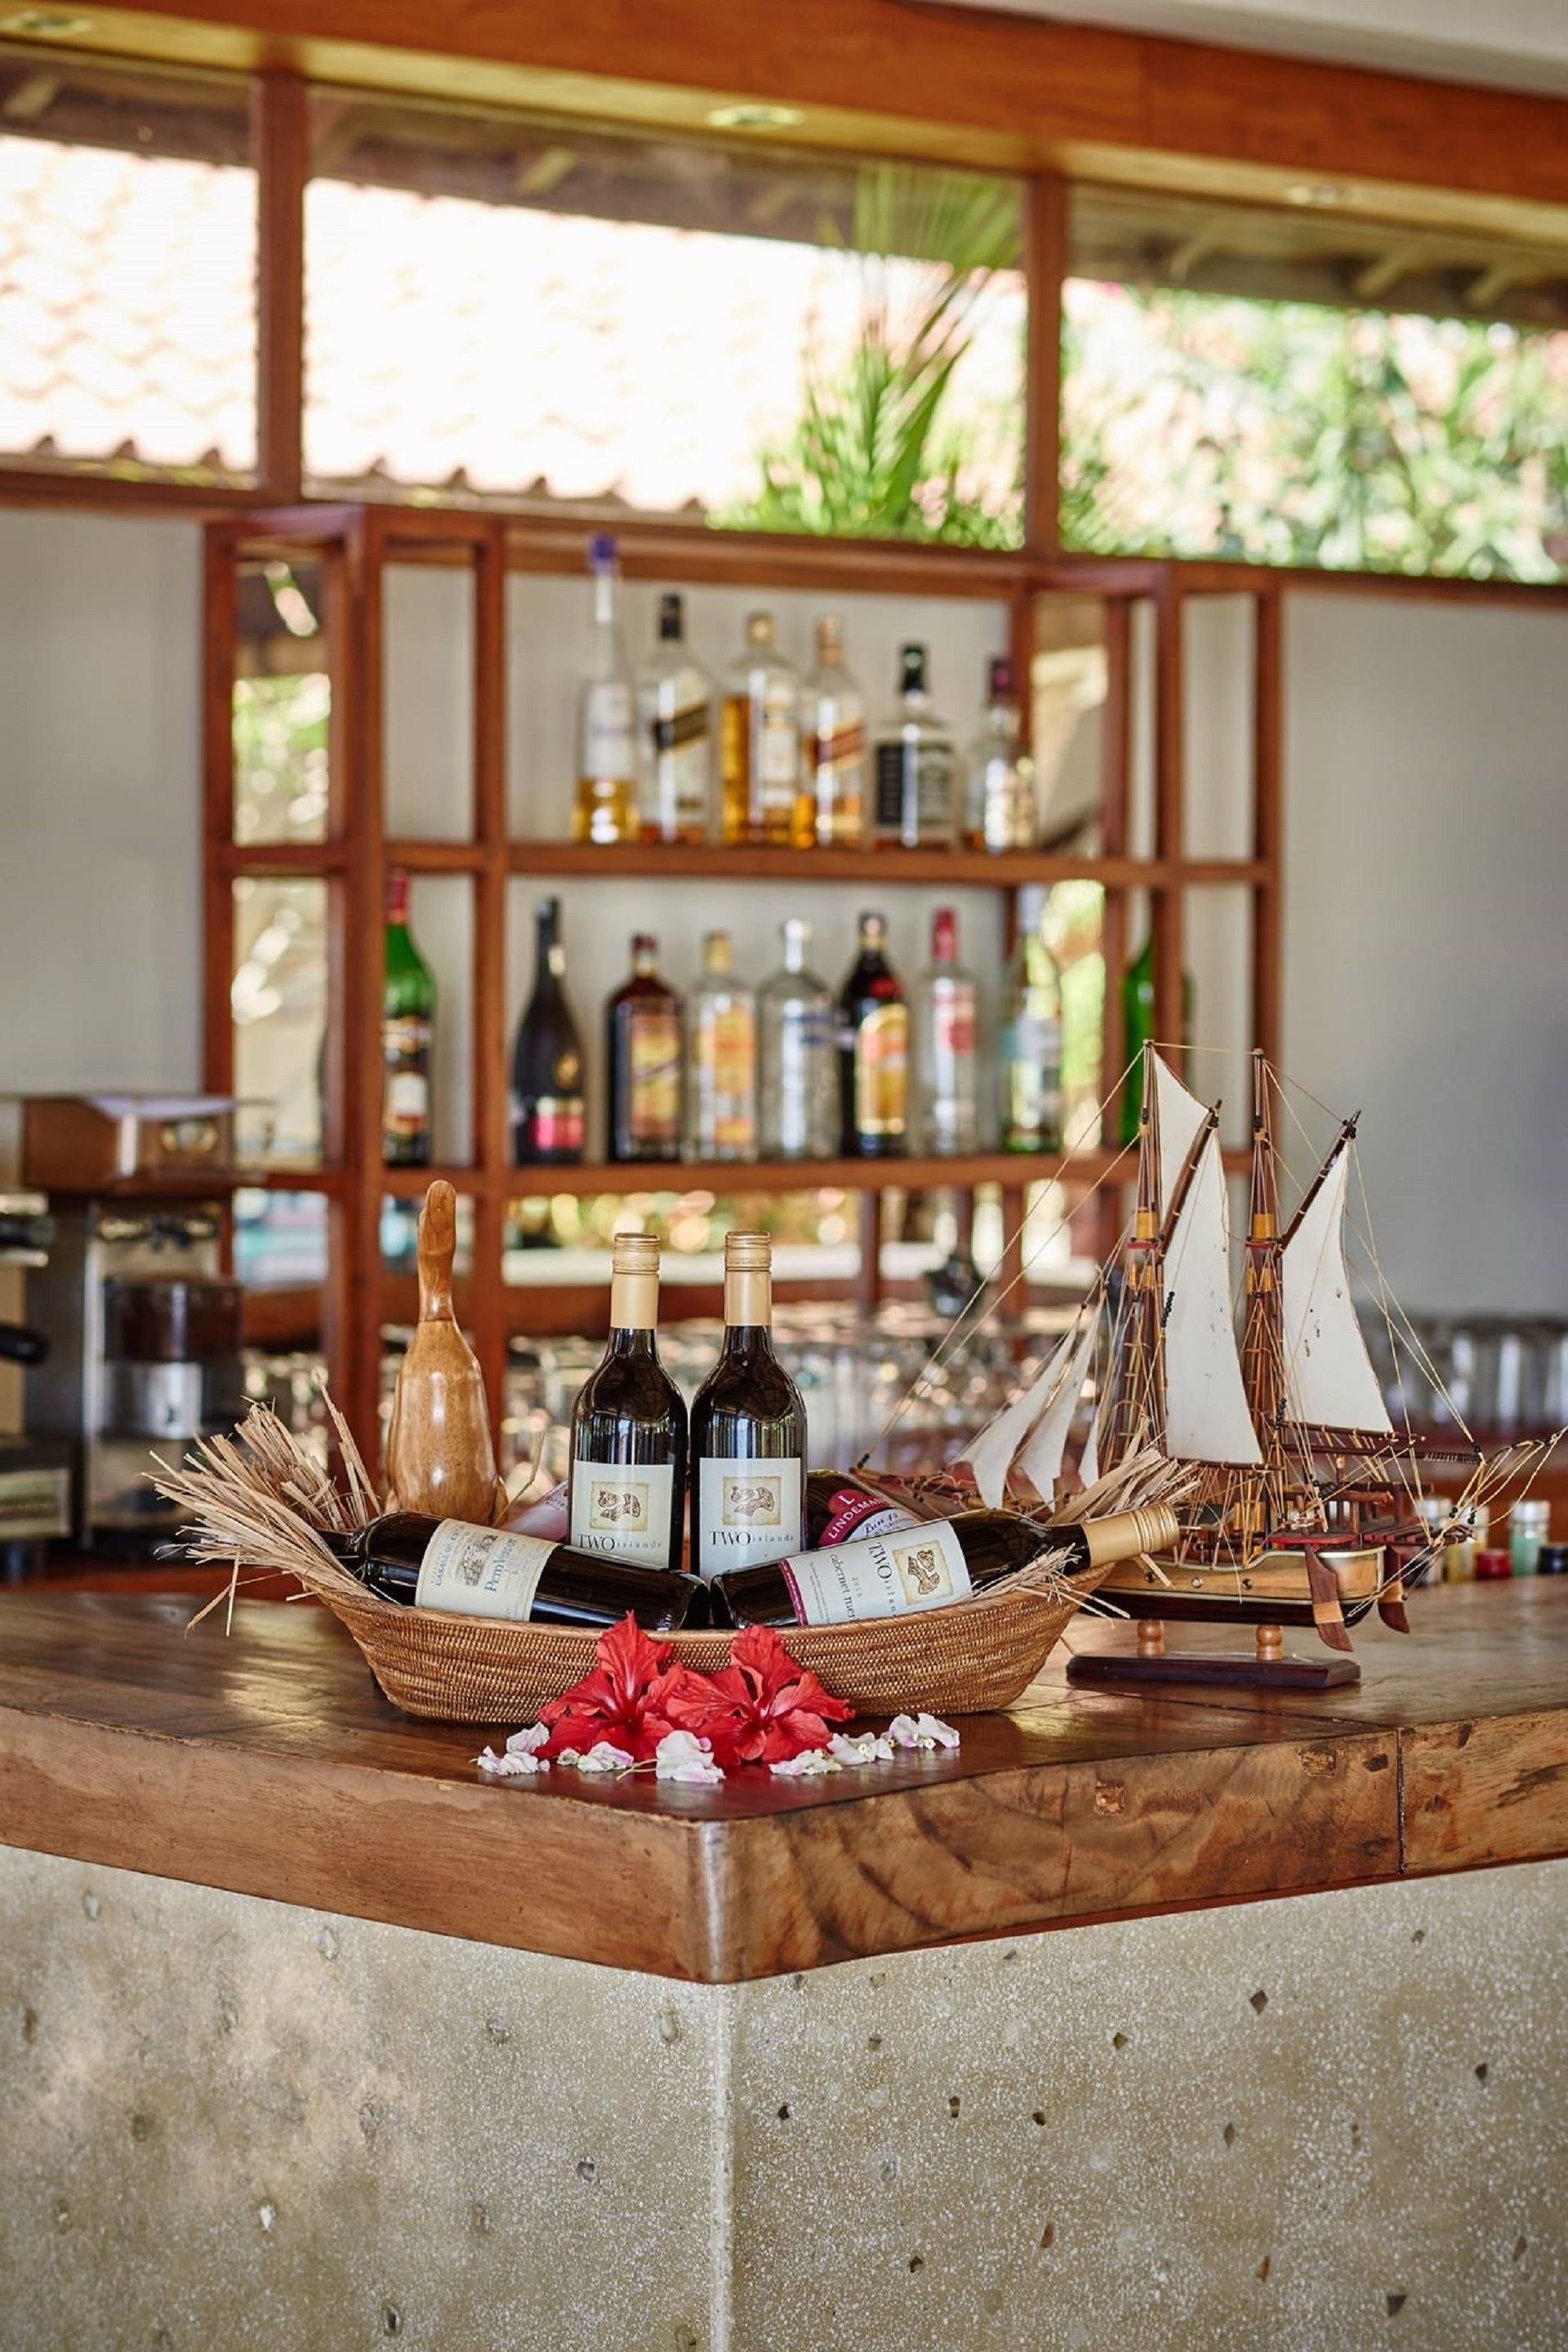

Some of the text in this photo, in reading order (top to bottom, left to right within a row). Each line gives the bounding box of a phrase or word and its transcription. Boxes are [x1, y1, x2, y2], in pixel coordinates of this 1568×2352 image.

[838, 1495, 855, 1505] L
[577, 1534, 615, 1551] TWO
[709, 1531, 751, 1547] TWO
[830, 1554, 849, 1593] cabernet
[868, 1542, 893, 1579] TWO
[884, 1579, 897, 1617] islan
